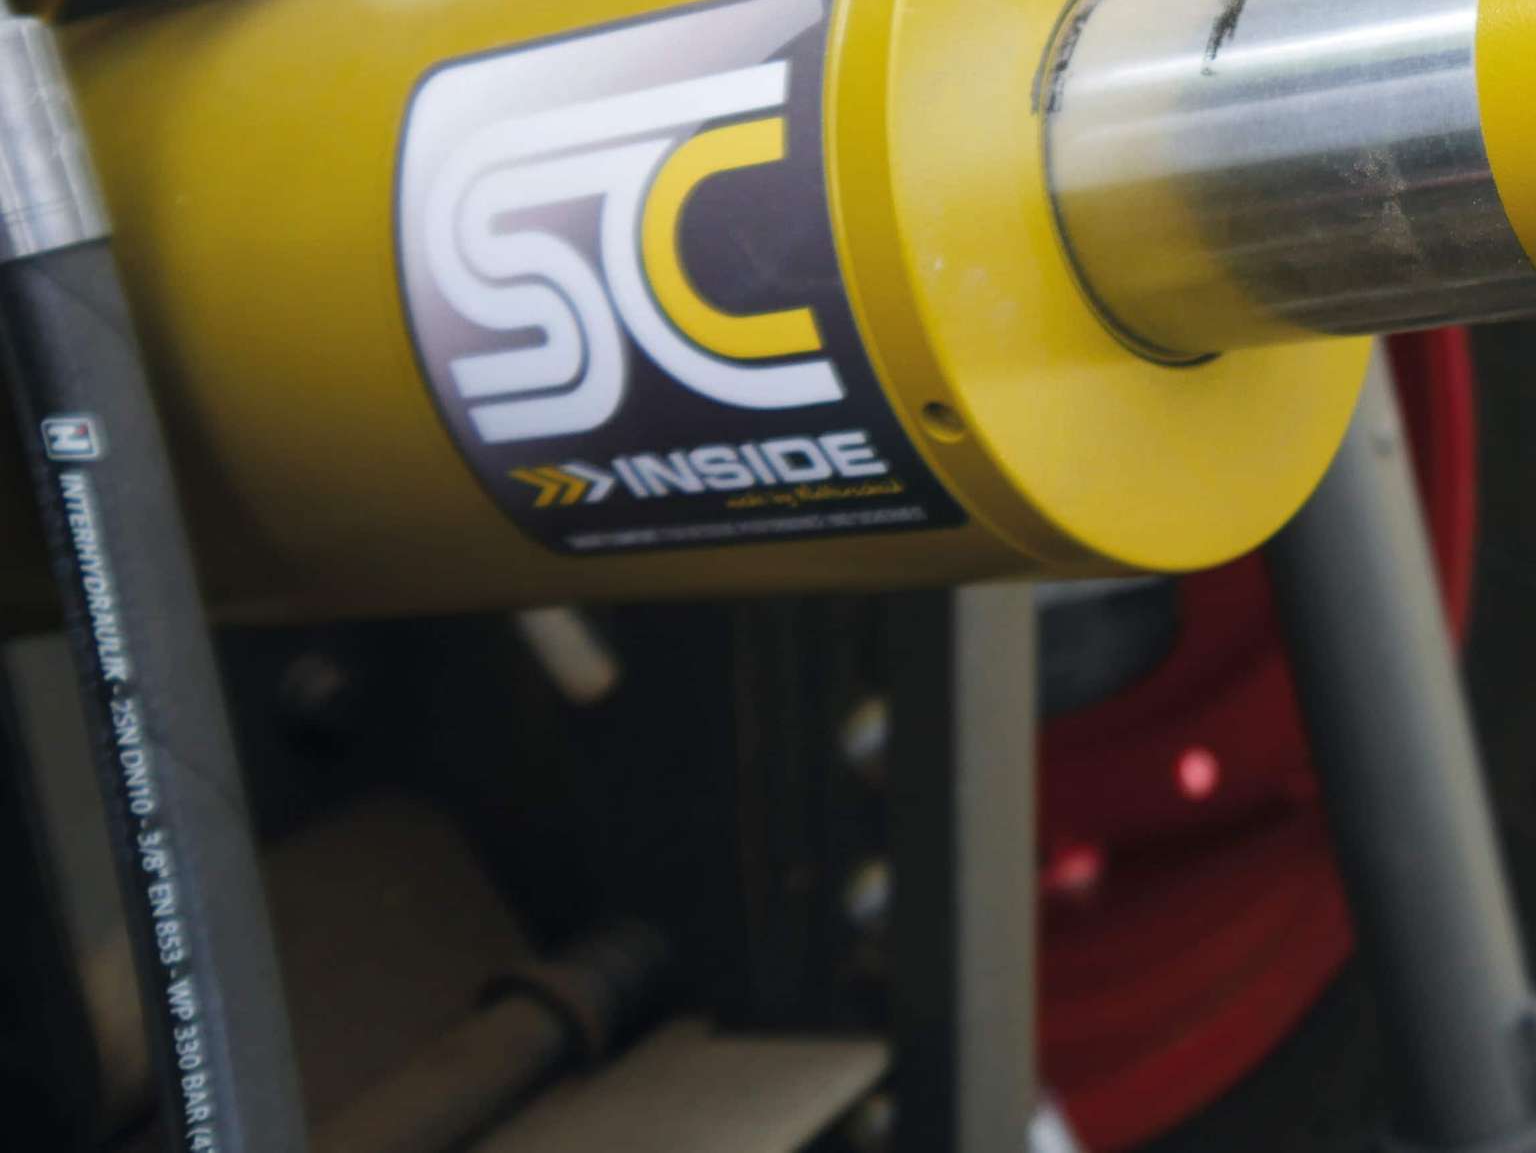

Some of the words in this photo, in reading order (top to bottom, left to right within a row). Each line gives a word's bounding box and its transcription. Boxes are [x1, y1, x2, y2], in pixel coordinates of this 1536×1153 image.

[612, 431, 889, 502] INSIDE
[59, 472, 130, 681] INTERHYDRAULIK
[110, 698, 141, 745] 2SN
[120, 749, 154, 815] DN10
[148, 882, 176, 917] EN
[155, 920, 184, 965] 853
[167, 979, 194, 1021] WP
[174, 1025, 202, 1070] 330
[181, 1072, 211, 1124] BAR
